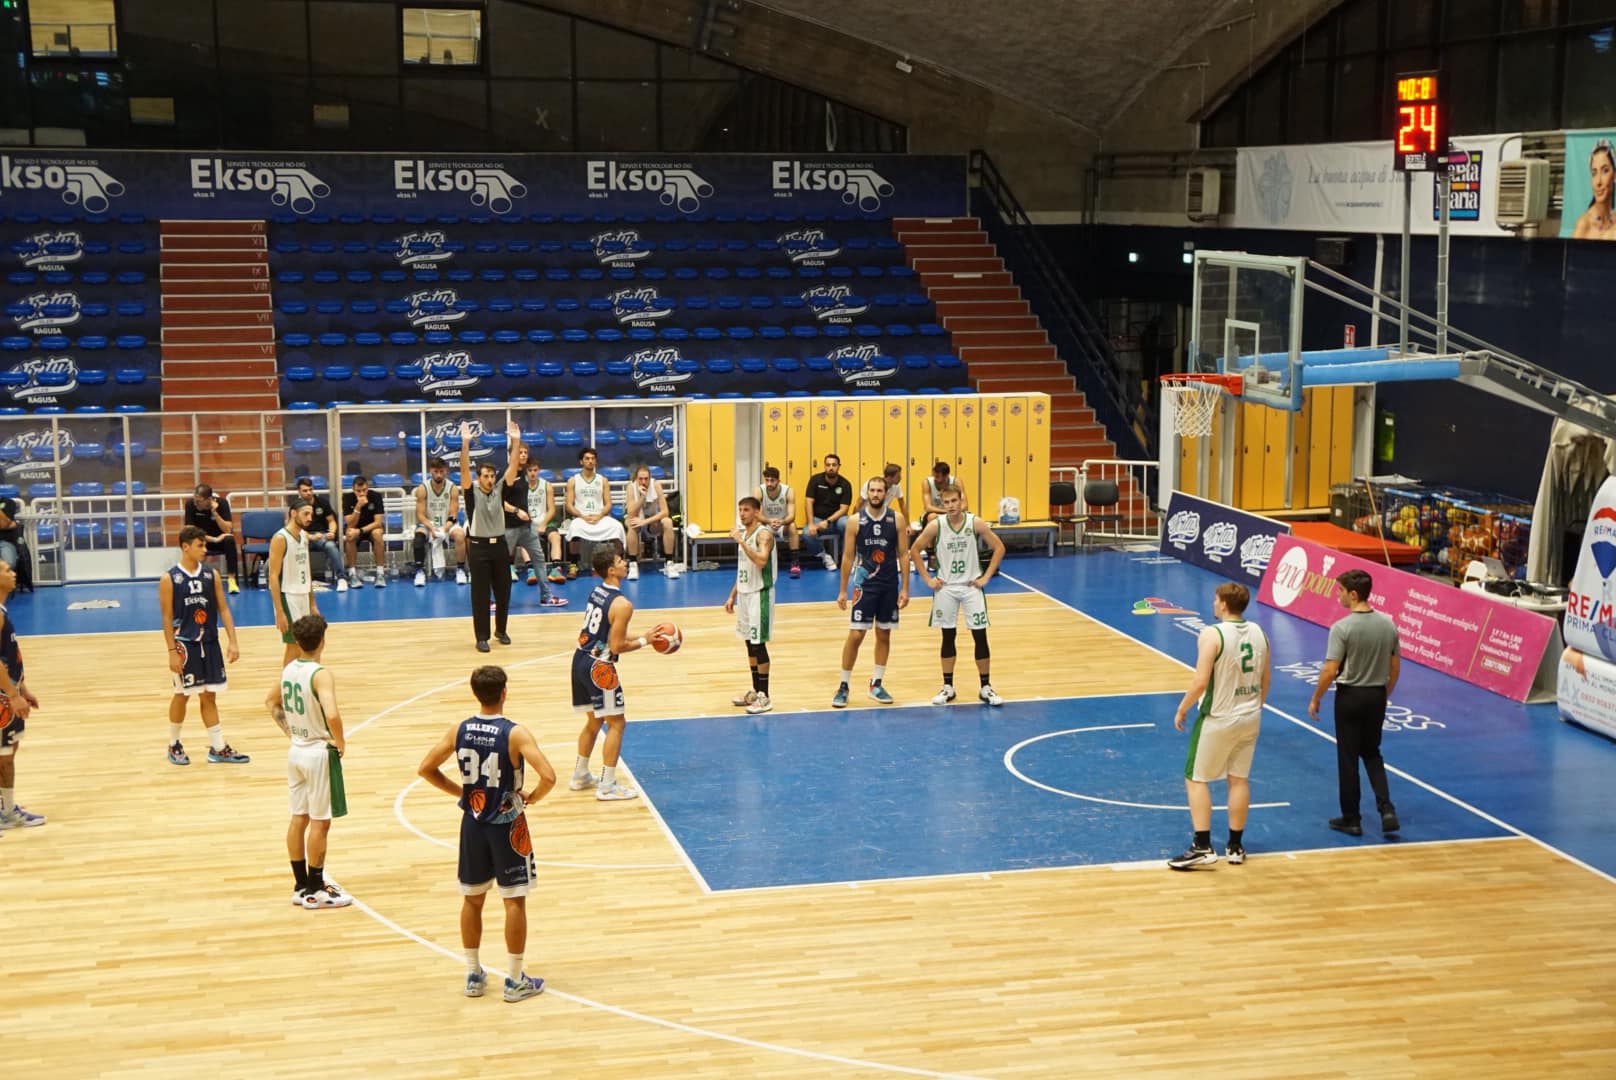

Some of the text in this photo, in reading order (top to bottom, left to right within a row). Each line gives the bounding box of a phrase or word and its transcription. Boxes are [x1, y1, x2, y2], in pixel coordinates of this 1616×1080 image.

[1399, 105, 1437, 151] 24
[0, 156, 65, 189] kso
[190, 158, 275, 191] Ekso
[394, 160, 474, 191] Ekso
[587, 161, 664, 191] Ekso
[772, 161, 846, 190] Ekso
[38, 264, 66, 272] RAGUSA
[33, 327, 62, 335] RAGUSA
[425, 323, 450, 331] RAGUSA
[28, 396, 58, 404] RAGUSA
[435, 389, 462, 397] RAGUSA
[449, 460, 477, 468] RAGA
[873, 524, 881, 535] 6
[1594, 525, 1616, 538] RE/MA
[951, 560, 966, 574] 32
[188, 580, 203, 594] 13
[854, 610, 863, 621] 6
[1567, 591, 1616, 628] RE/M
[972, 611, 987, 625] 32
[1240, 643, 1254, 673] 2
[283, 681, 305, 715] 26
[458, 748, 501, 788] 34
